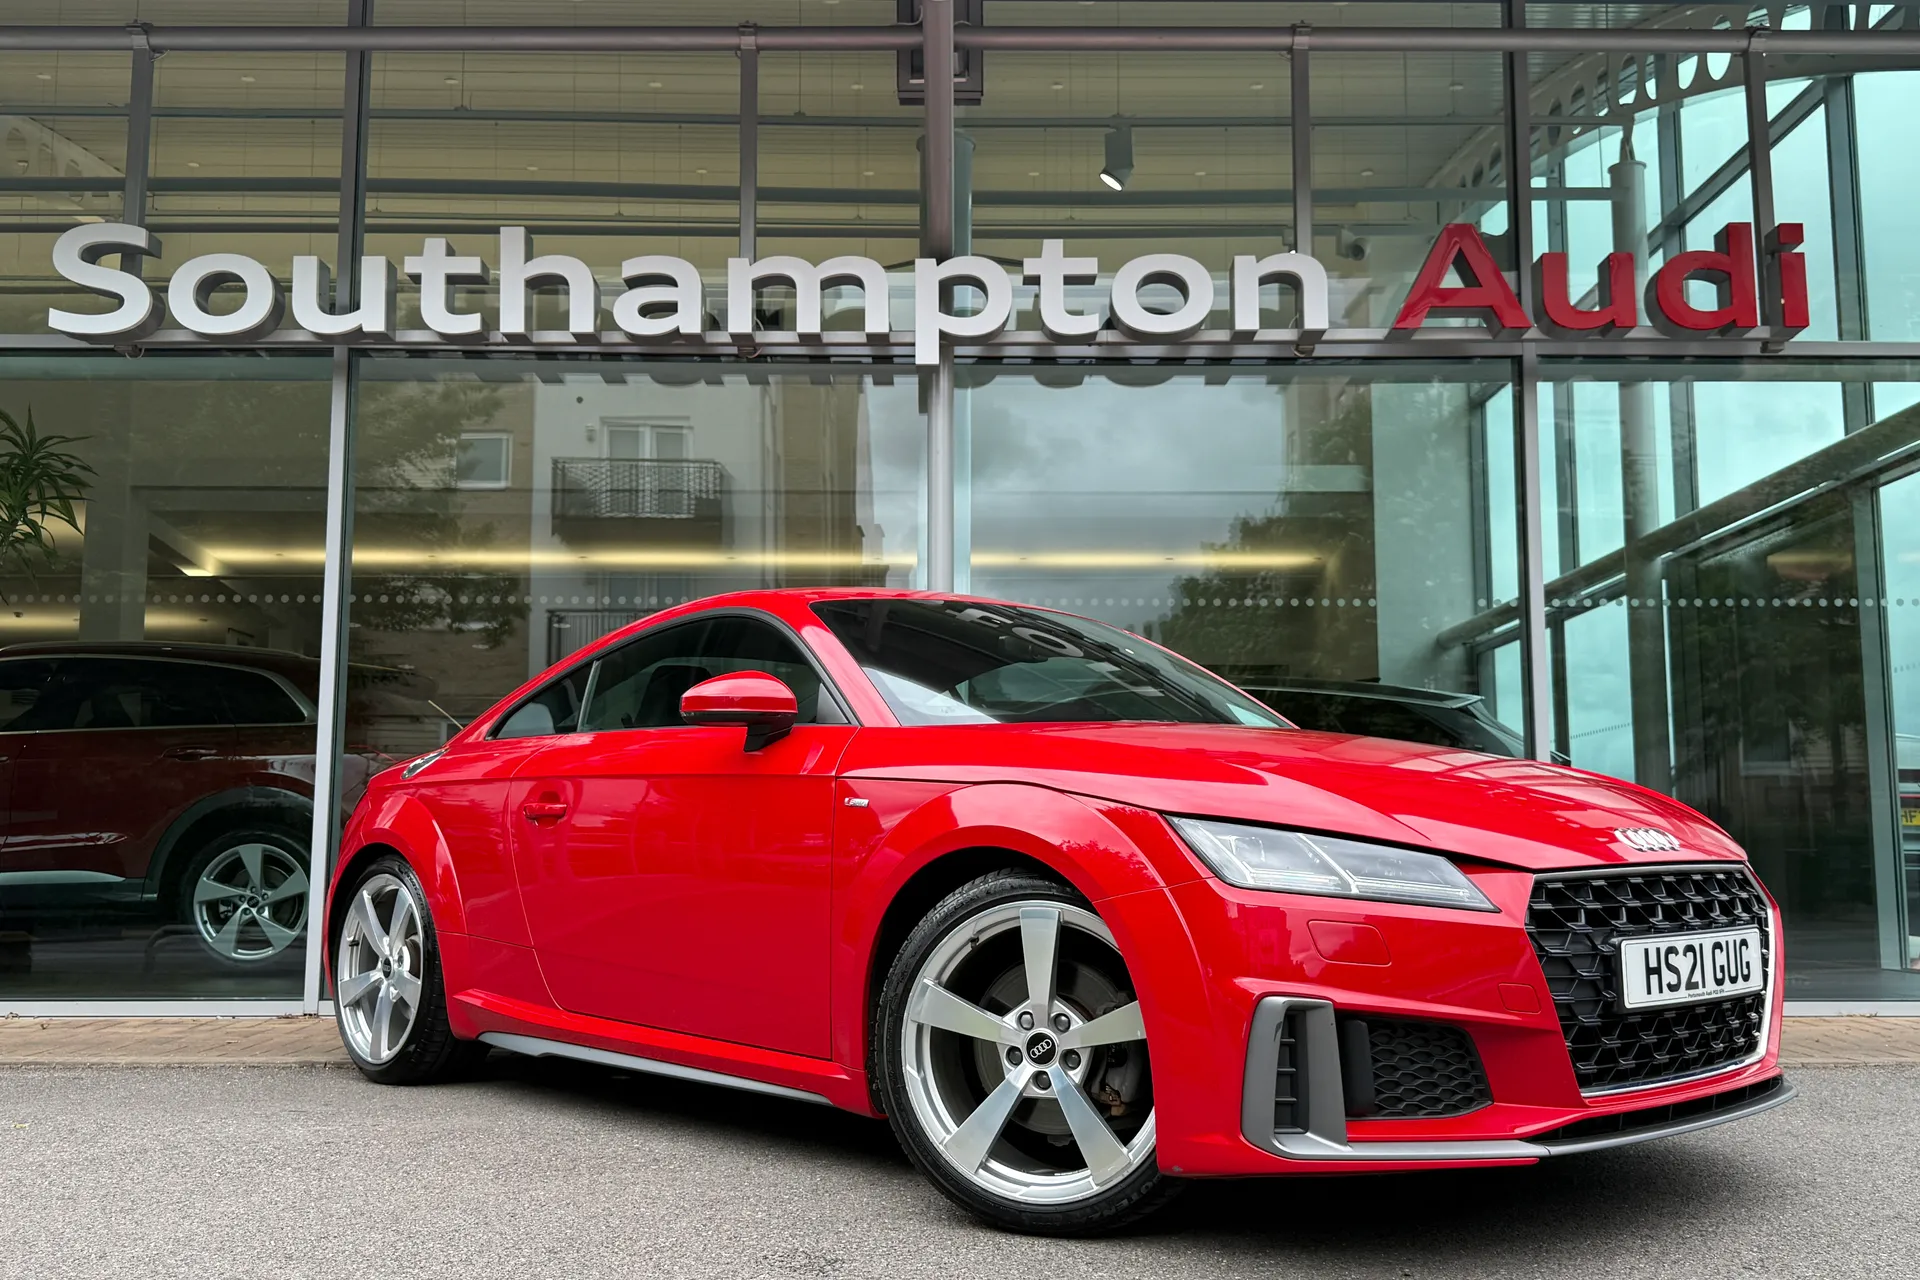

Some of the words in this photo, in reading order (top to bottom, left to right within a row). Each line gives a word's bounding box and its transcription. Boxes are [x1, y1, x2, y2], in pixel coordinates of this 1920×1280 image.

[48, 222, 1330, 366] Southampton
[1393, 221, 1810, 332] Audi
[1901, 810, 1920, 823] HF
[1644, 943, 1706, 995] HS21
[1711, 938, 1751, 987] GUG
